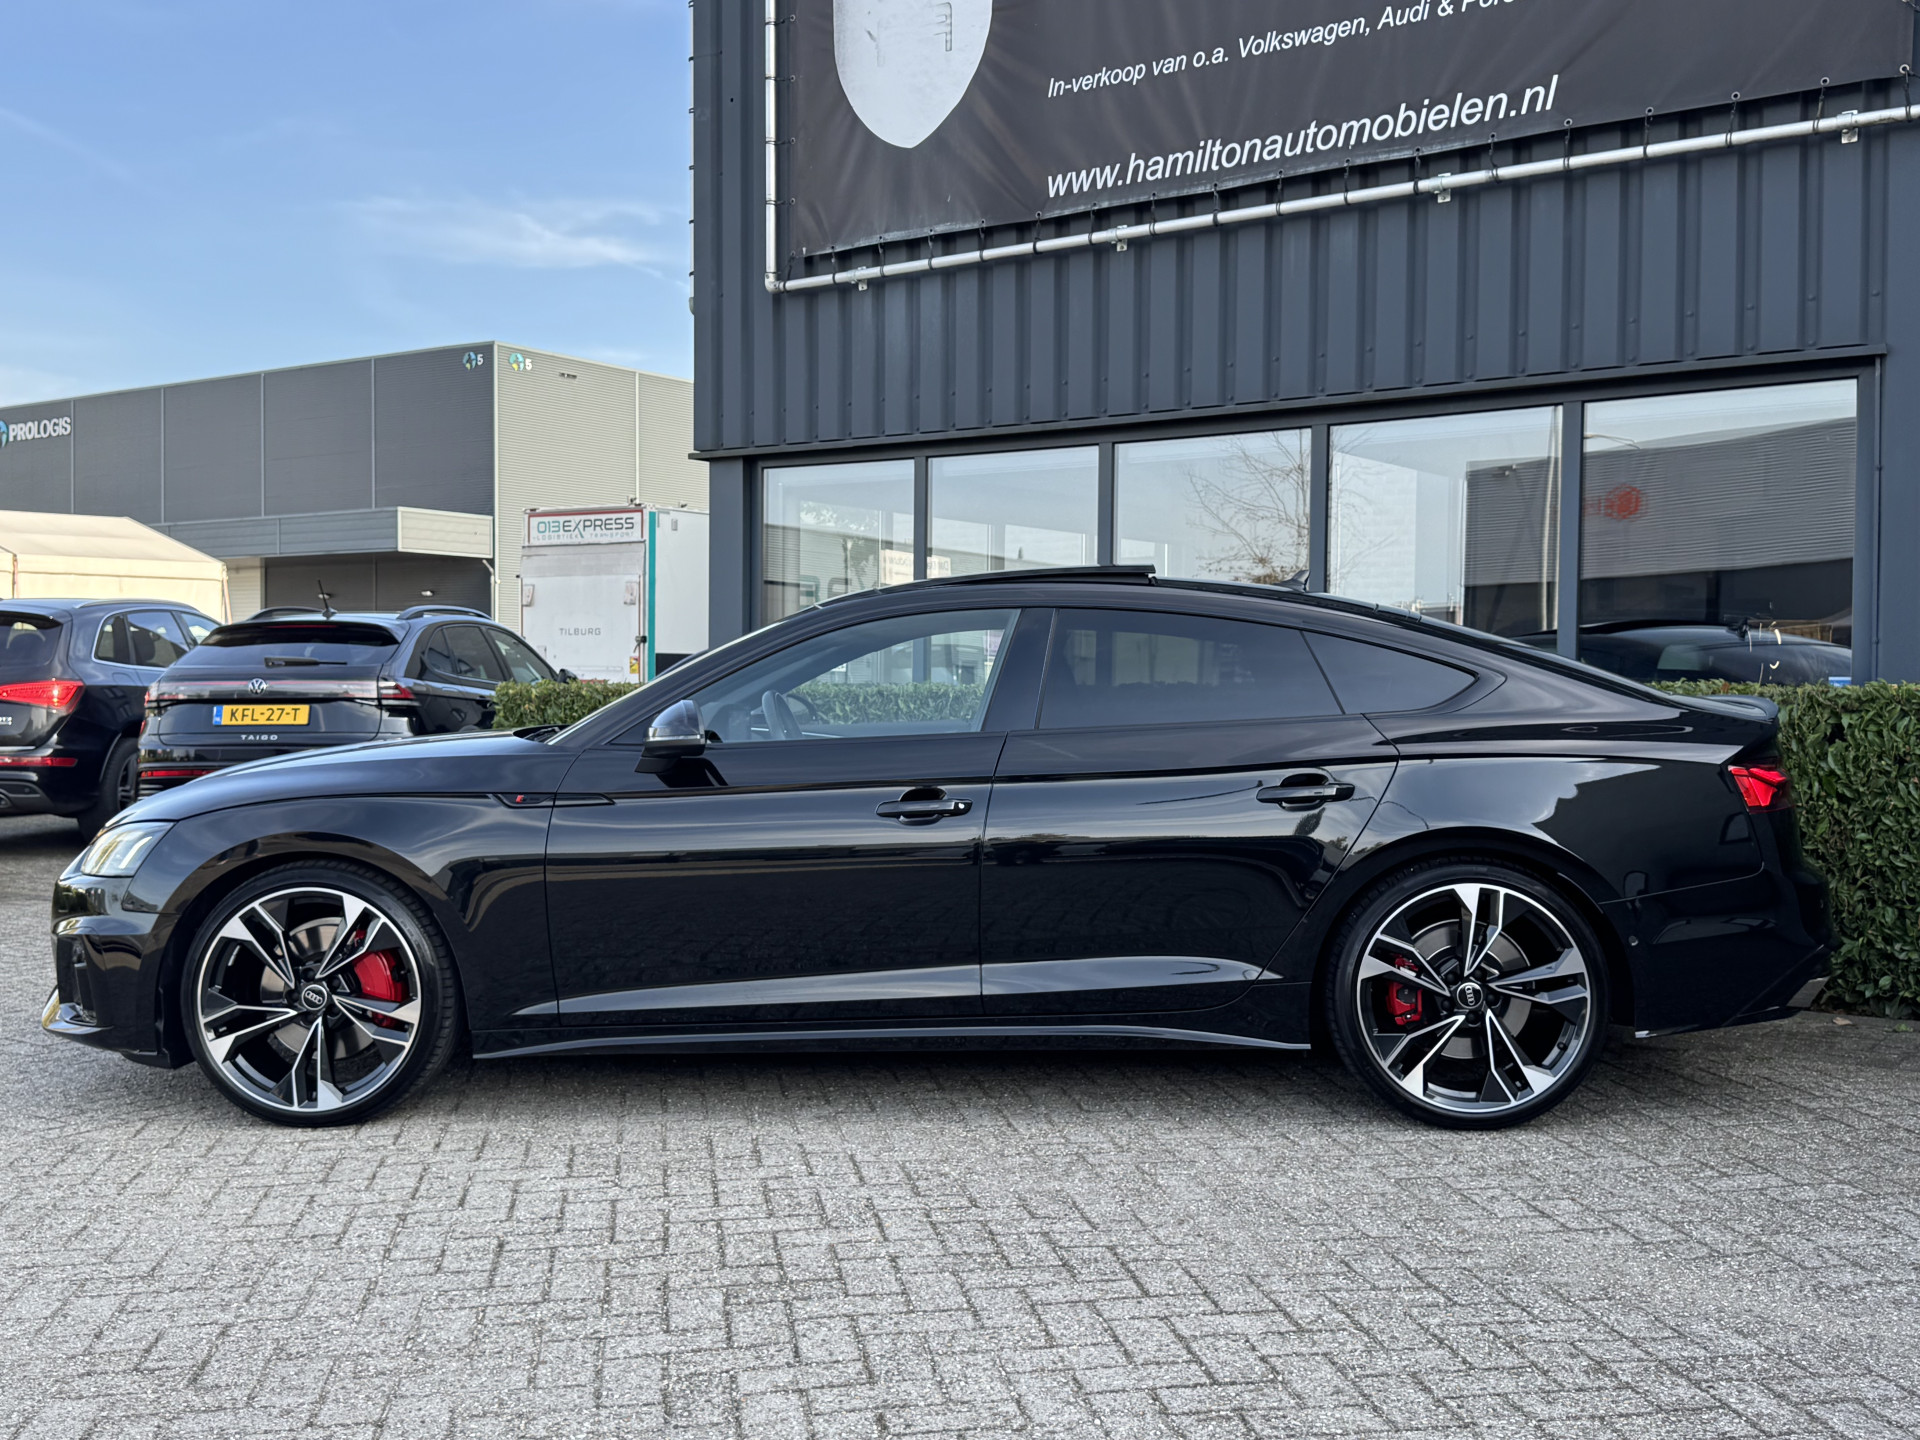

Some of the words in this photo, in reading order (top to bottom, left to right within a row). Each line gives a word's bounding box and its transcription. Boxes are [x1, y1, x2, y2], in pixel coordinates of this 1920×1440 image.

[1047, 63, 1146, 98] In-verkoop
[1152, 54, 1187, 76] van
[1193, 47, 1229, 68] o.a.
[1238, 16, 1371, 58] Volkswagen,
[1377, 0, 1430, 30] Audi
[1437, 0, 1454, 17] &
[1047, 74, 1559, 198] www.hamiltonautomobielen.nl
[476, 354, 484, 366] 5
[525, 358, 533, 371] 5
[8, 416, 72, 442] PROLOGIS
[559, 627, 602, 636] TILBURG
[229, 707, 301, 722] KFL-27-T
